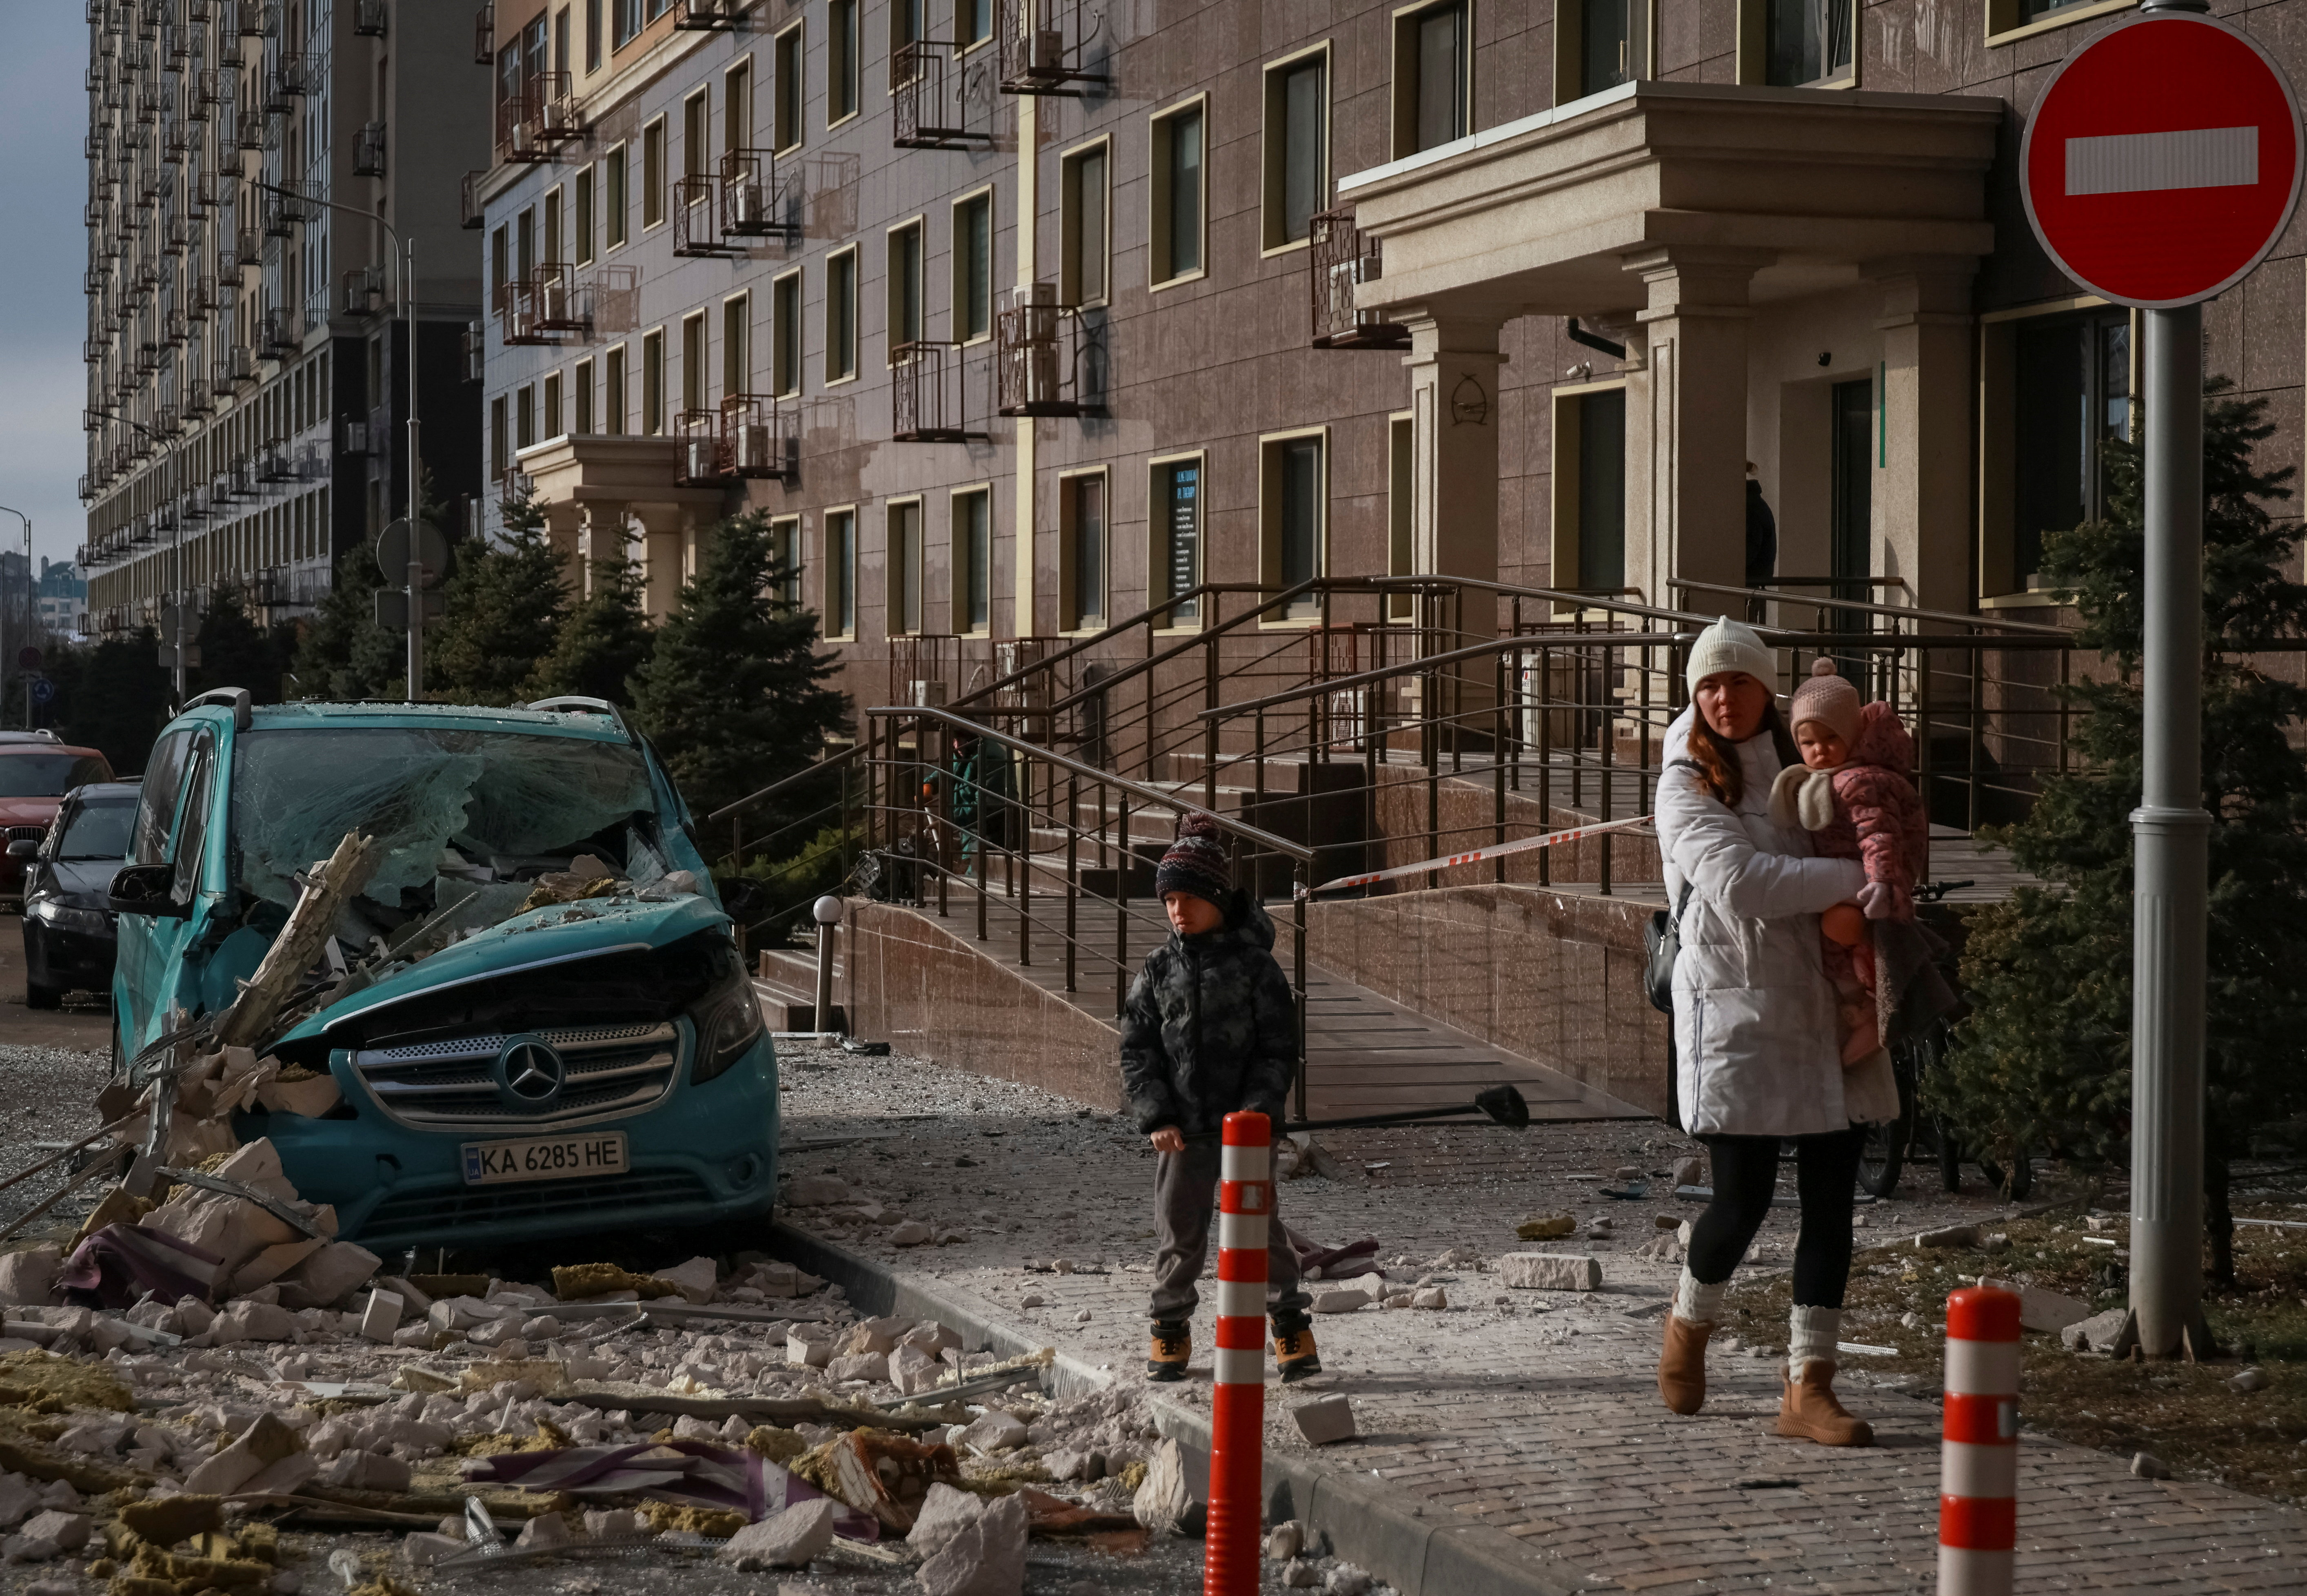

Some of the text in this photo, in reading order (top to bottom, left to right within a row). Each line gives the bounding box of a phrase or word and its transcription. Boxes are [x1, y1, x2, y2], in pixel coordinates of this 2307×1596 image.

[481, 1140, 618, 1175] KA 6285 HE
[469, 1168, 480, 1176] UA
